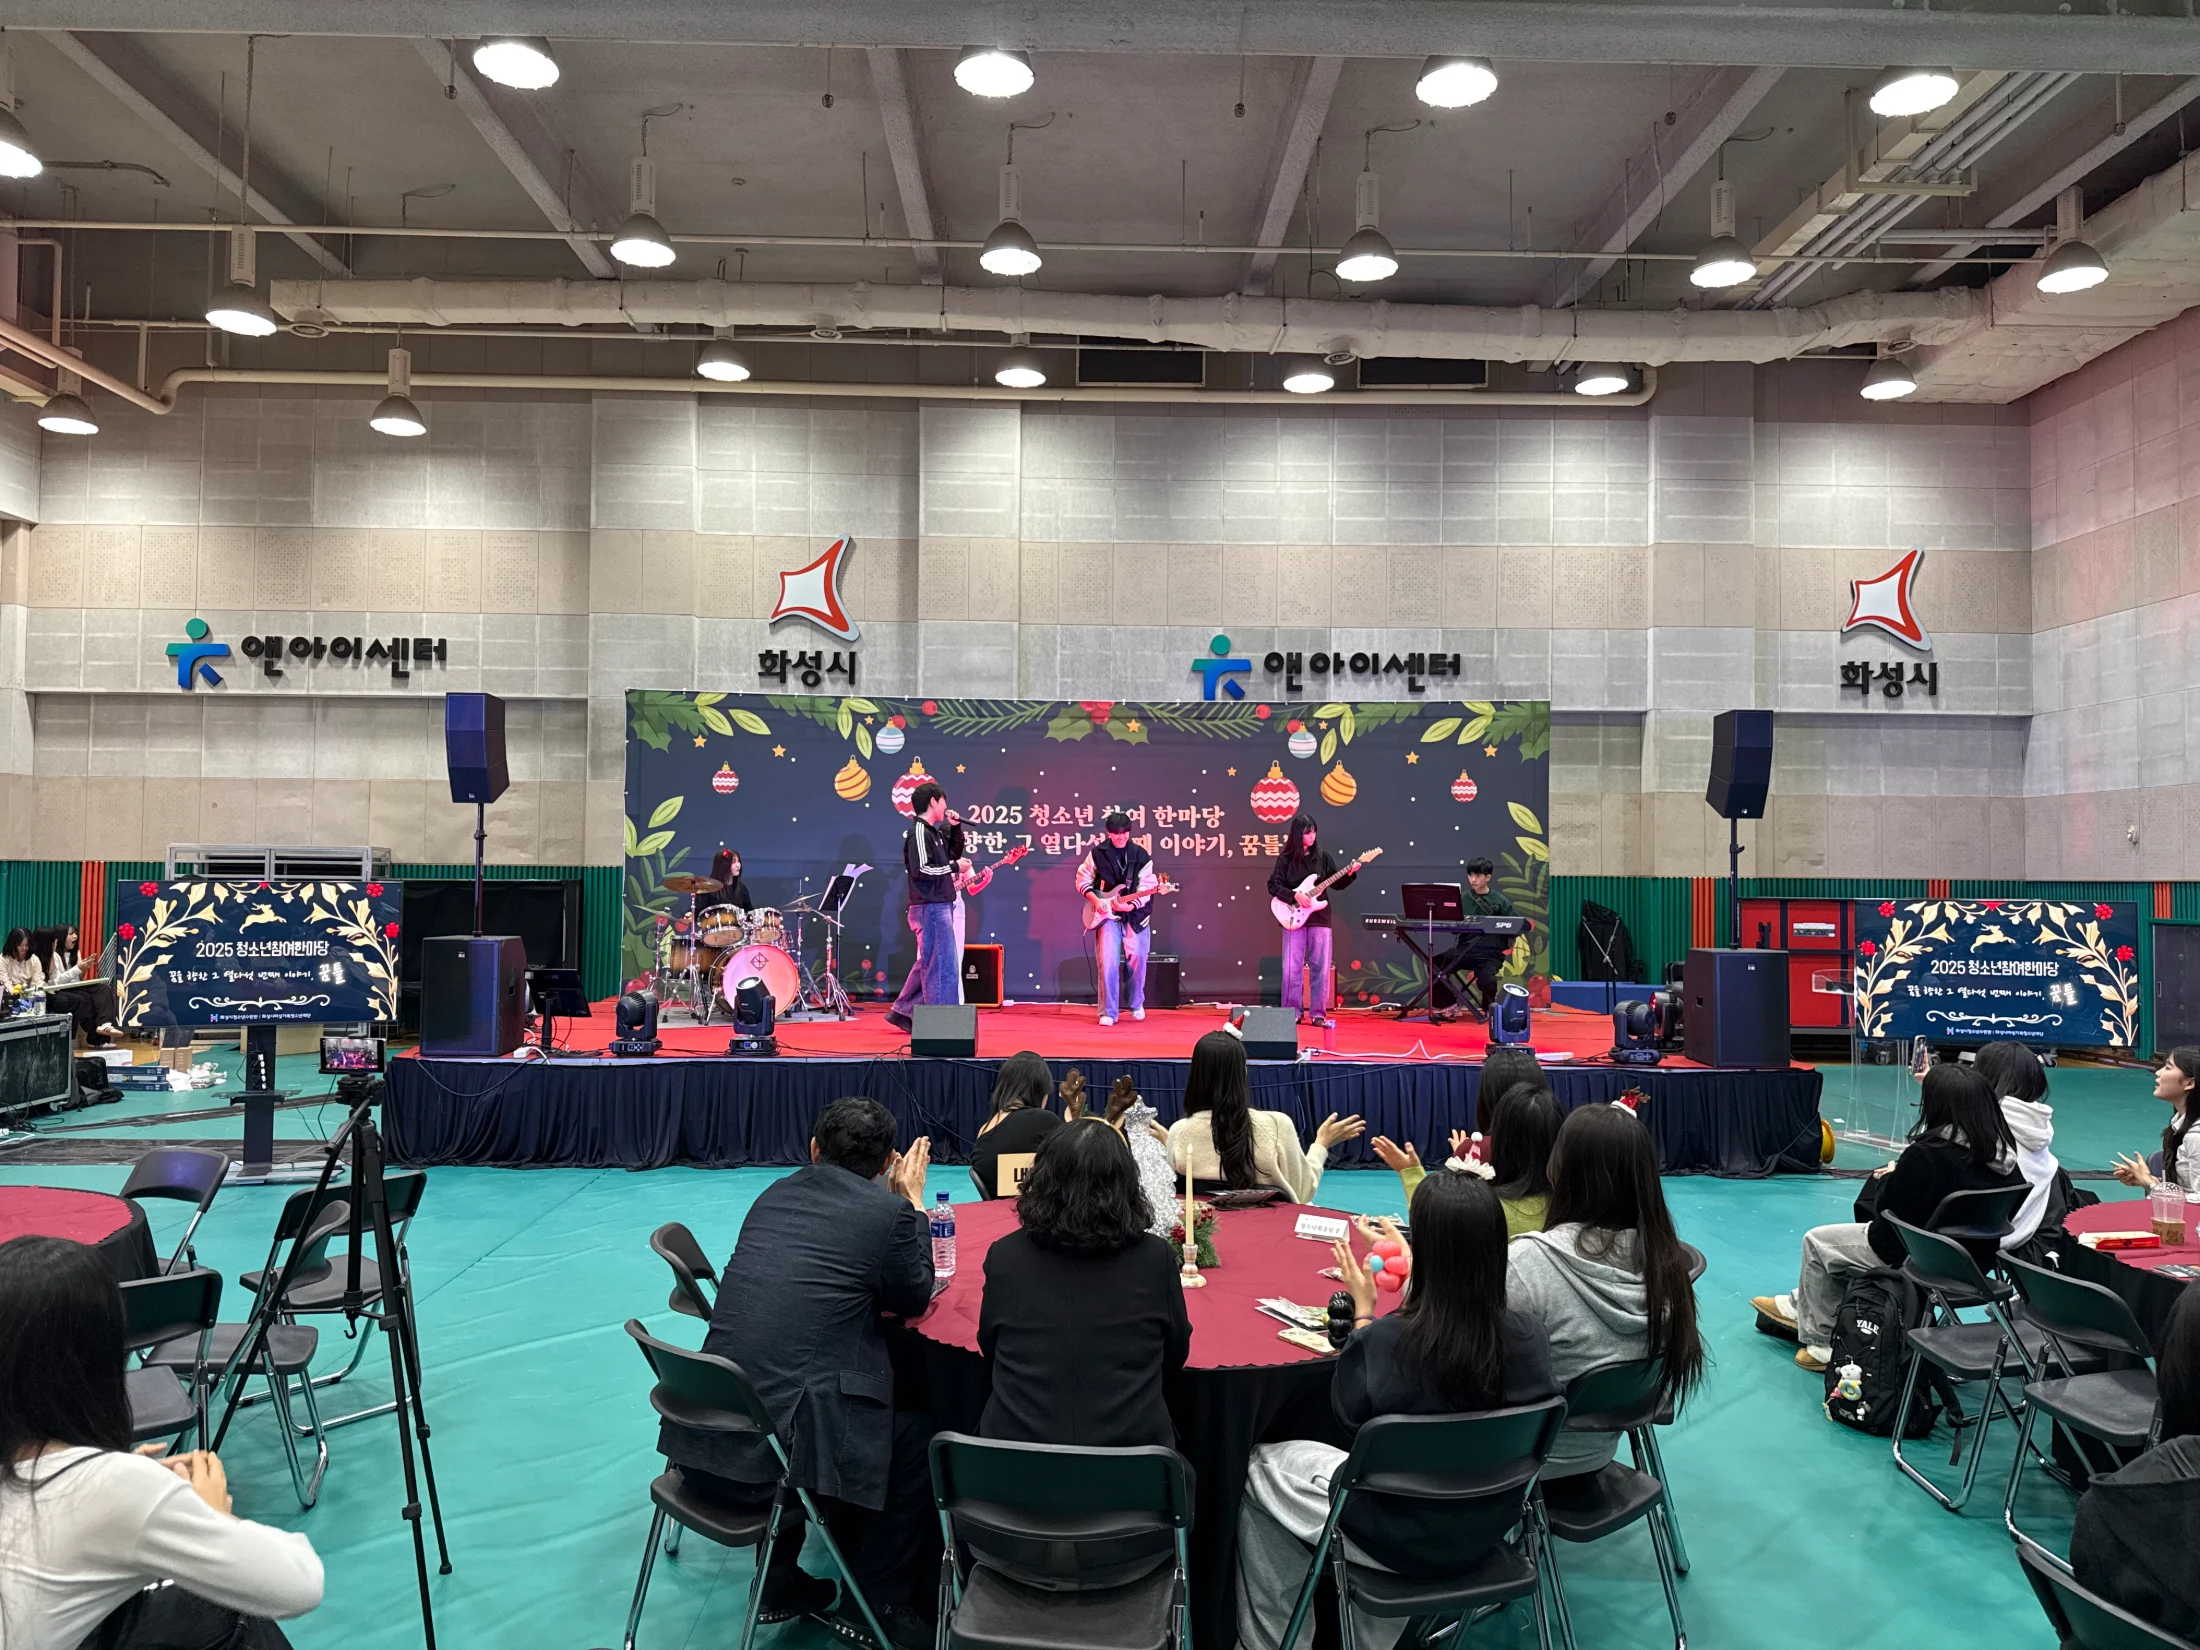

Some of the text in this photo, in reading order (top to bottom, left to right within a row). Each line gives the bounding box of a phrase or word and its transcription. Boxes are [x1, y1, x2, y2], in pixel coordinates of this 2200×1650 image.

[241, 635, 447, 678] 앤아이센터
[758, 650, 857, 688] 화성시
[1264, 651, 1461, 692] 앤아이센터
[1840, 661, 1938, 698] 화성시
[968, 804, 1023, 825] 2025
[1029, 804, 1095, 827] 청소년
[1152, 805, 1226, 828] 한마당
[963, 831, 1008, 854] 향한
[1015, 834, 1035, 852] 그
[1160, 833, 1234, 858] 이야기,
[196, 940, 330, 958] 2025 청소년참여한마당
[168, 970, 184, 983] 꿈을
[186, 971, 208, 982] 향한
[212, 972, 220, 980] 그
[318, 961, 347, 985] 꿈틀
[1930, 960, 2059, 977] 2025 청소년참여한마당
[1906, 985, 1921, 997] 꿈을
[1923, 986, 1943, 996] 향한
[1946, 988, 1954, 996] 그
[2049, 982, 2078, 1006] 꿈틀
[1856, 1319, 1880, 1336] YALE
